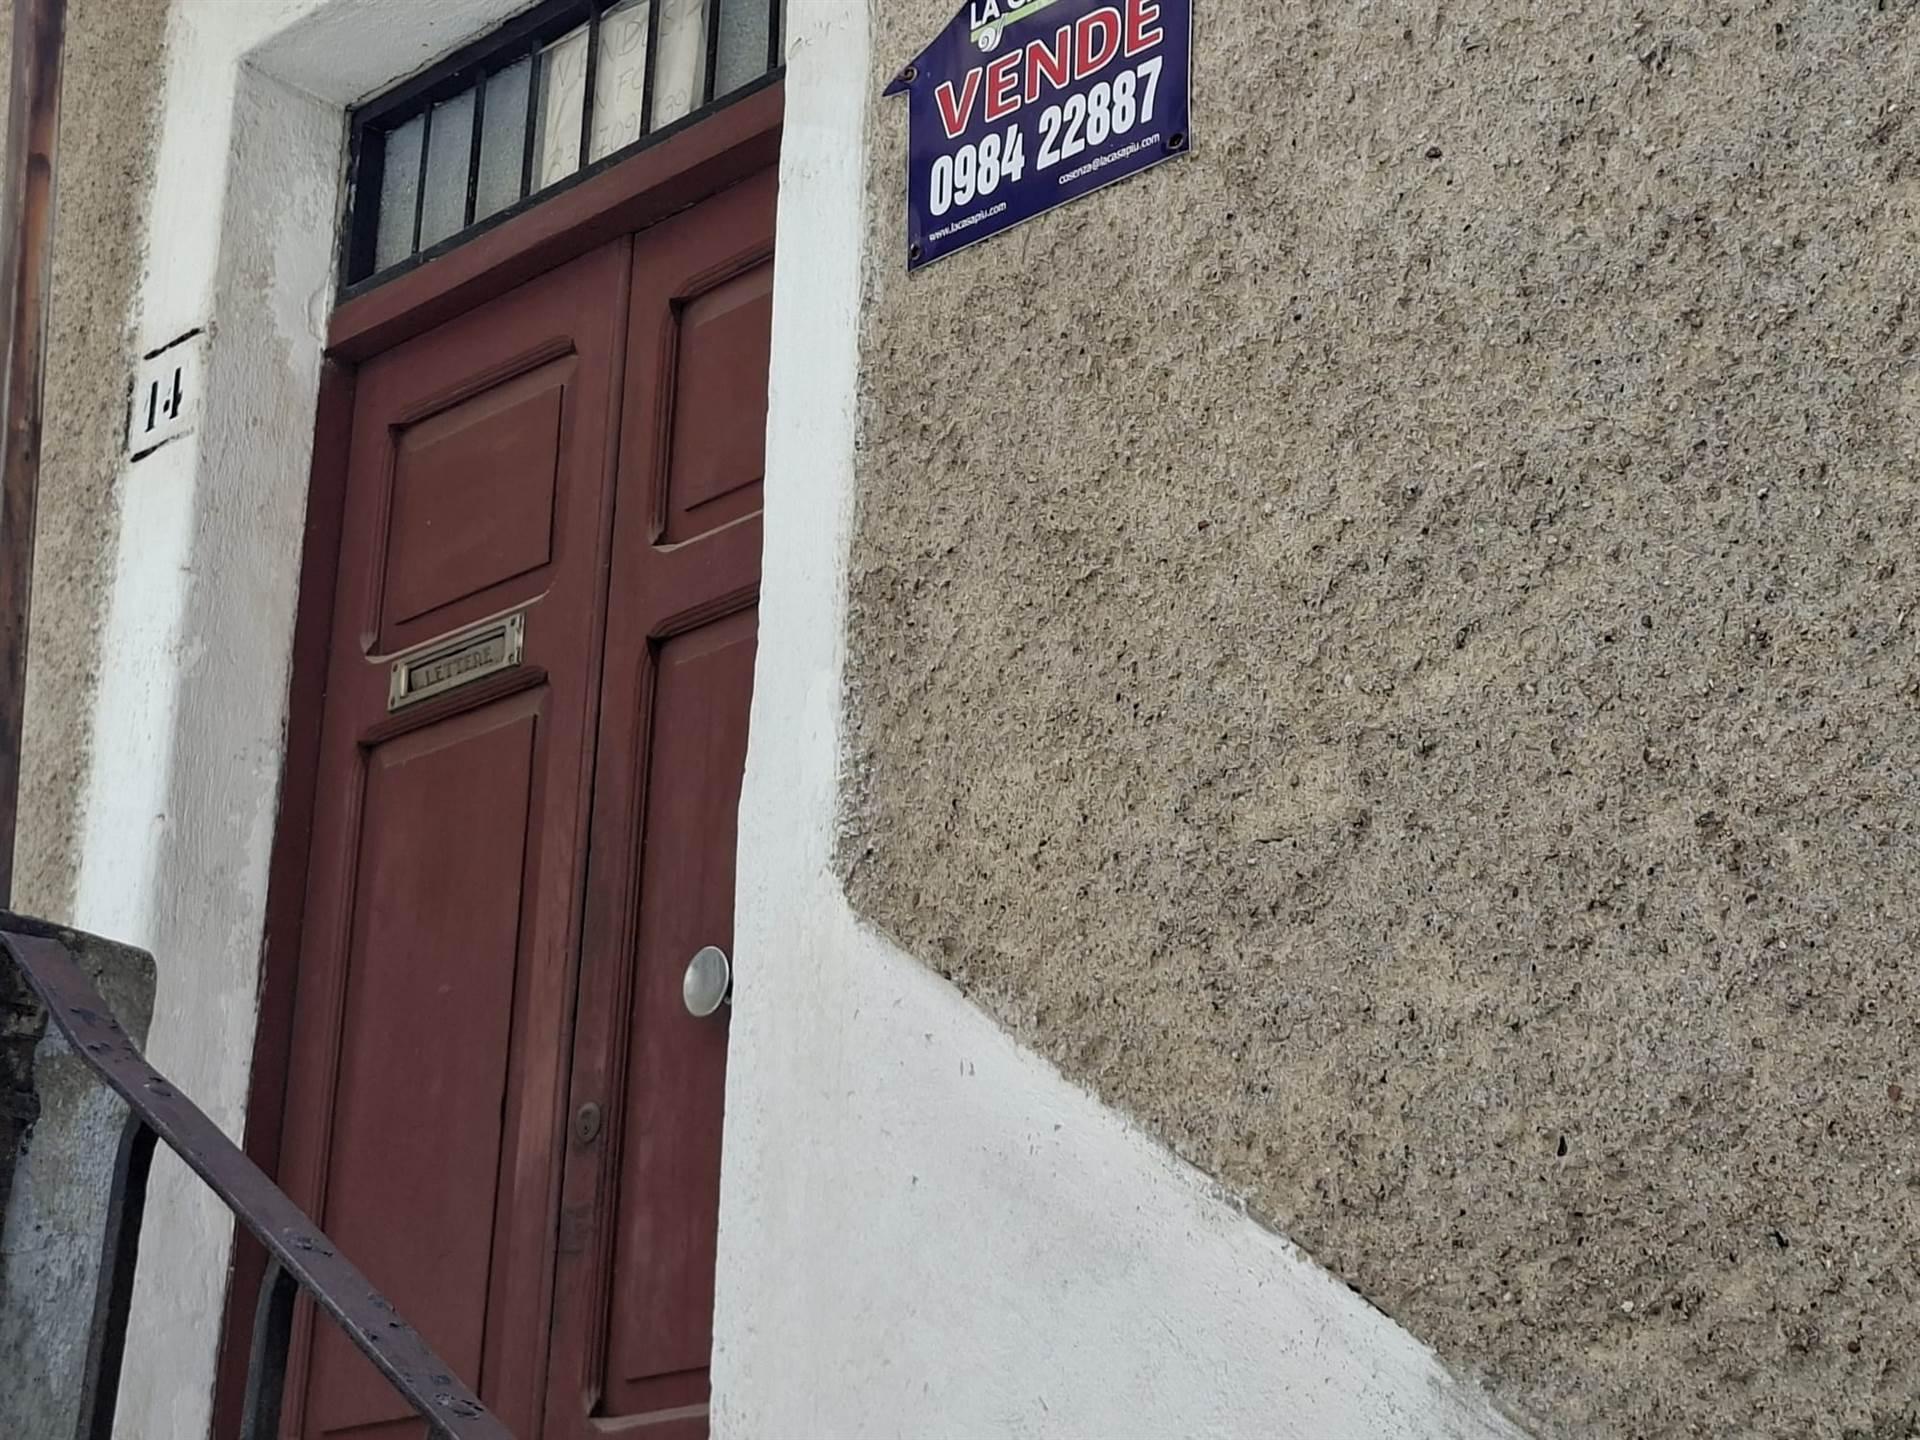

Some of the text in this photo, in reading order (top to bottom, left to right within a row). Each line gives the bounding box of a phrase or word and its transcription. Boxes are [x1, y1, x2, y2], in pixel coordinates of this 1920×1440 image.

[935, 0, 1164, 139] VENDE
[970, 0, 1000, 30] LA
[929, 55, 1163, 217] 0984 22887
